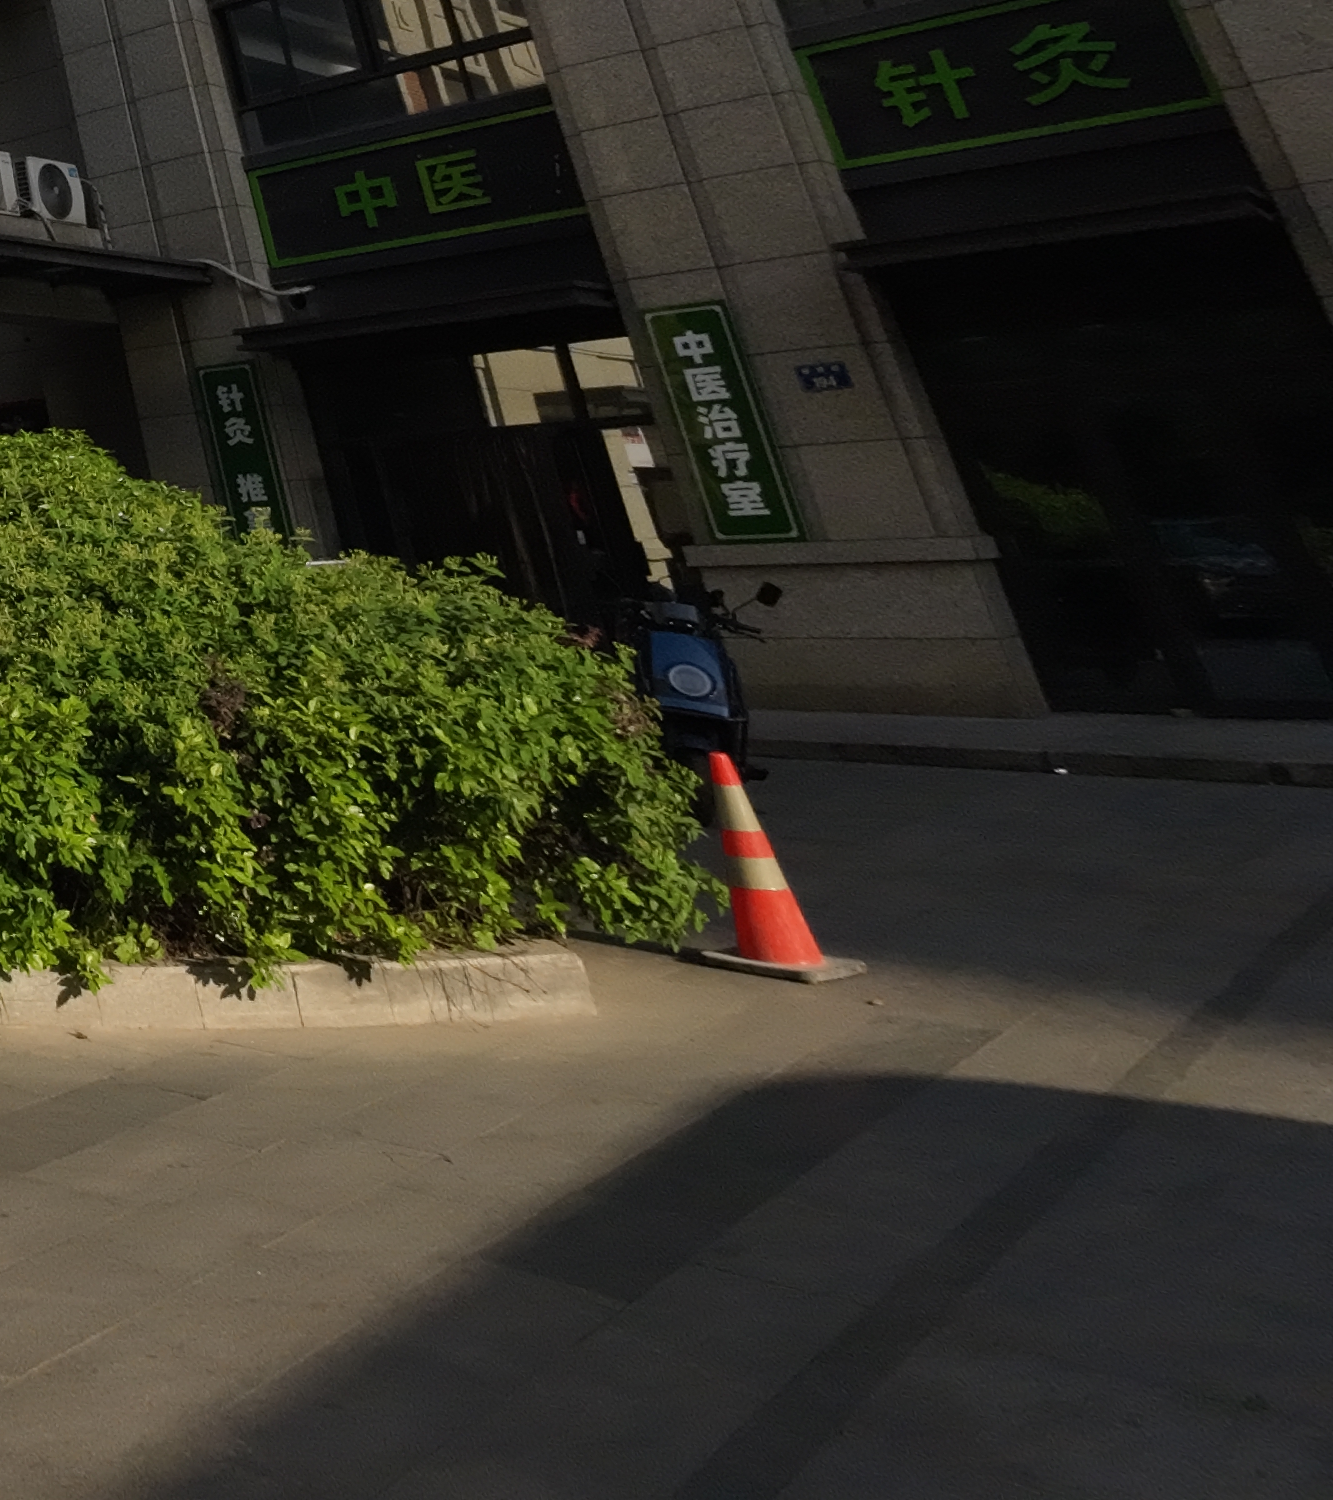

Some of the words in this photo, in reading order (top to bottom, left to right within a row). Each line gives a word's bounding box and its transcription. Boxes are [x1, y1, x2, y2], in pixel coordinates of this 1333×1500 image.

[874, 22, 1131, 127] 针灸
[334, 148, 492, 228] 中医
[216, 384, 254, 446] 针灸
[236, 473, 275, 532] 推
[673, 329, 771, 516] 中医治疗室
